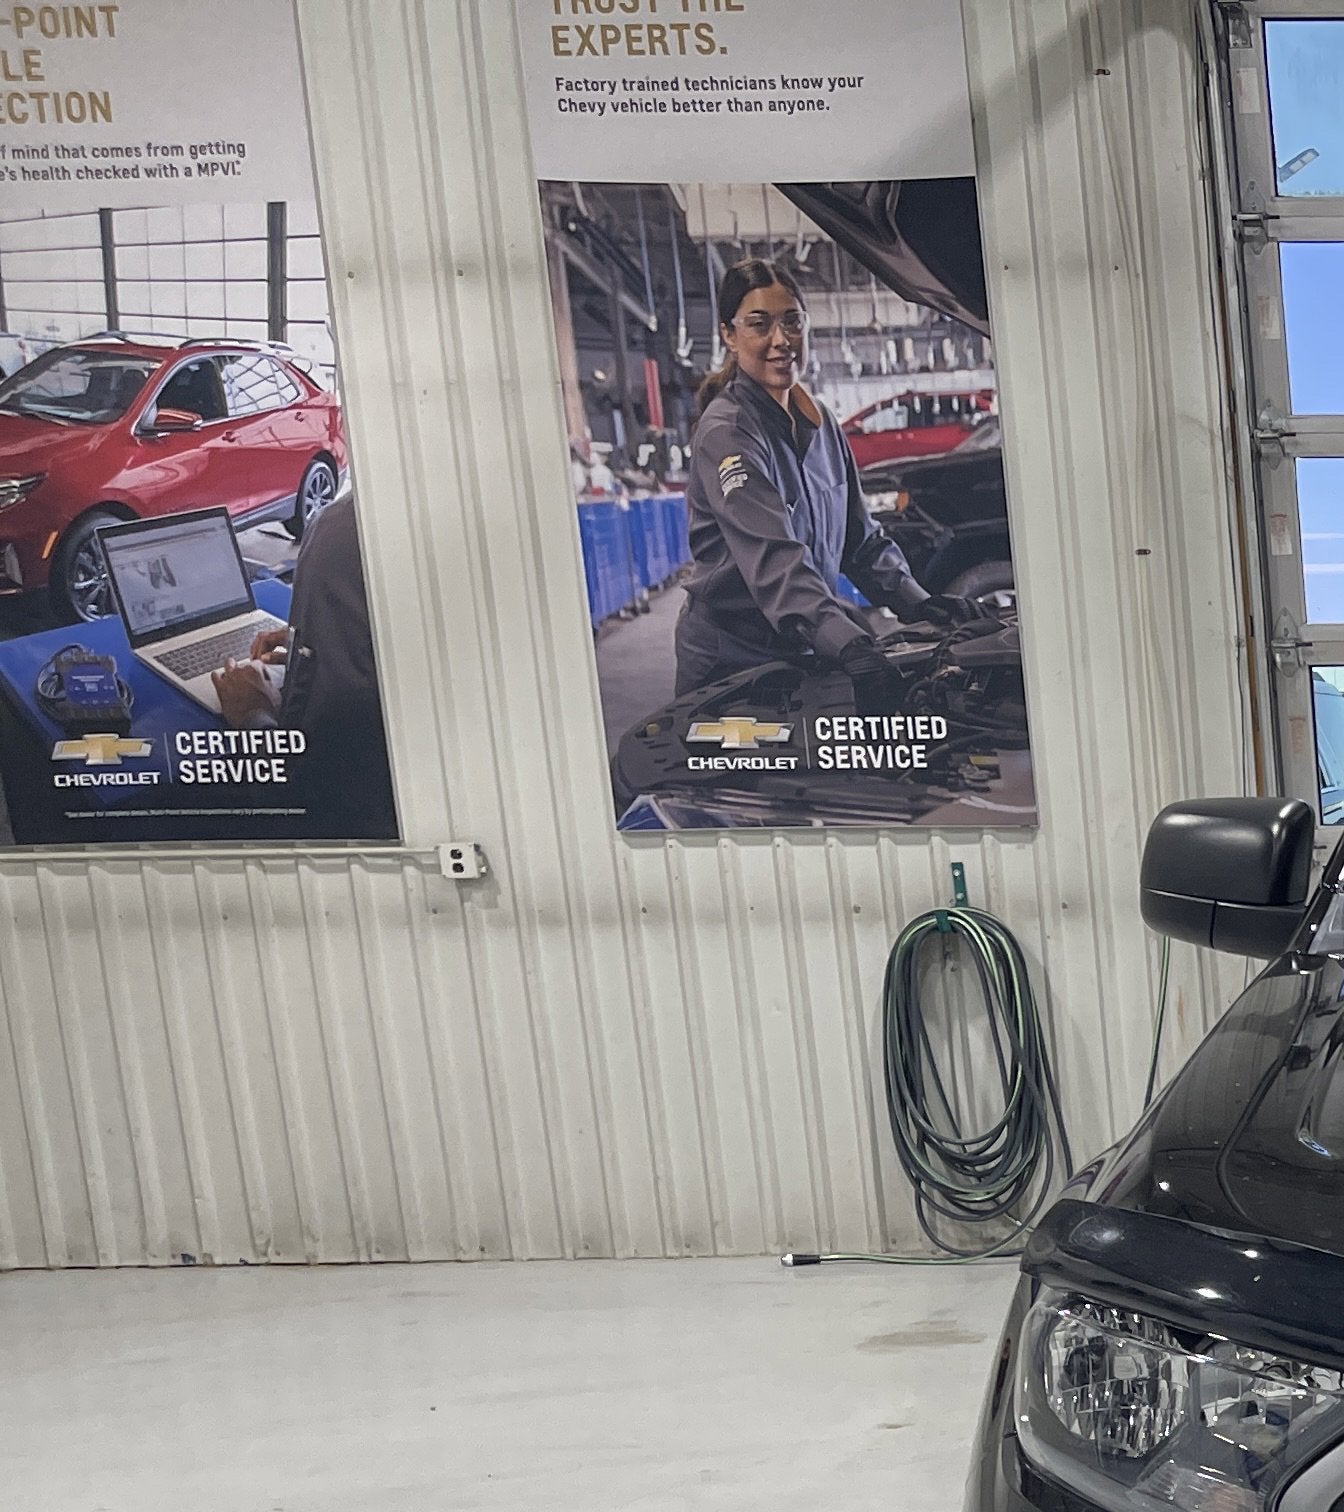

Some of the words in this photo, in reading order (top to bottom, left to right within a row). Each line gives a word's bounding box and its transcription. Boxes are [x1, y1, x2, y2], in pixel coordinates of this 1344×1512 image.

[551, 22, 728, 56] EXPERTS.
[555, 77, 617, 96] Factory
[621, 75, 680, 92] trained
[684, 75, 777, 92] technicians
[780, 75, 824, 90] know
[827, 76, 864, 92] your
[0, 91, 113, 125] CTION
[557, 98, 607, 117] Chevy
[610, 98, 668, 113] vehicle
[671, 97, 722, 113] better
[726, 97, 763, 113] than
[768, 98, 830, 115] anyone.
[11, 144, 50, 160] mind
[54, 144, 88, 159] that
[91, 145, 142, 159] comes
[146, 142, 185, 158] from
[189, 141, 246, 160] getting
[21, 165, 72, 181] health
[75, 164, 140, 180] checked
[143, 163, 179, 178] with
[184, 166, 193, 177] a
[815, 715, 948, 740] CERTIFIED
[175, 729, 307, 755] CERTIFIED
[687, 756, 799, 771] CHEVROLET
[817, 744, 928, 770] SERVICE
[53, 771, 161, 788] CHEVROLET
[178, 759, 288, 784] SERVICE
